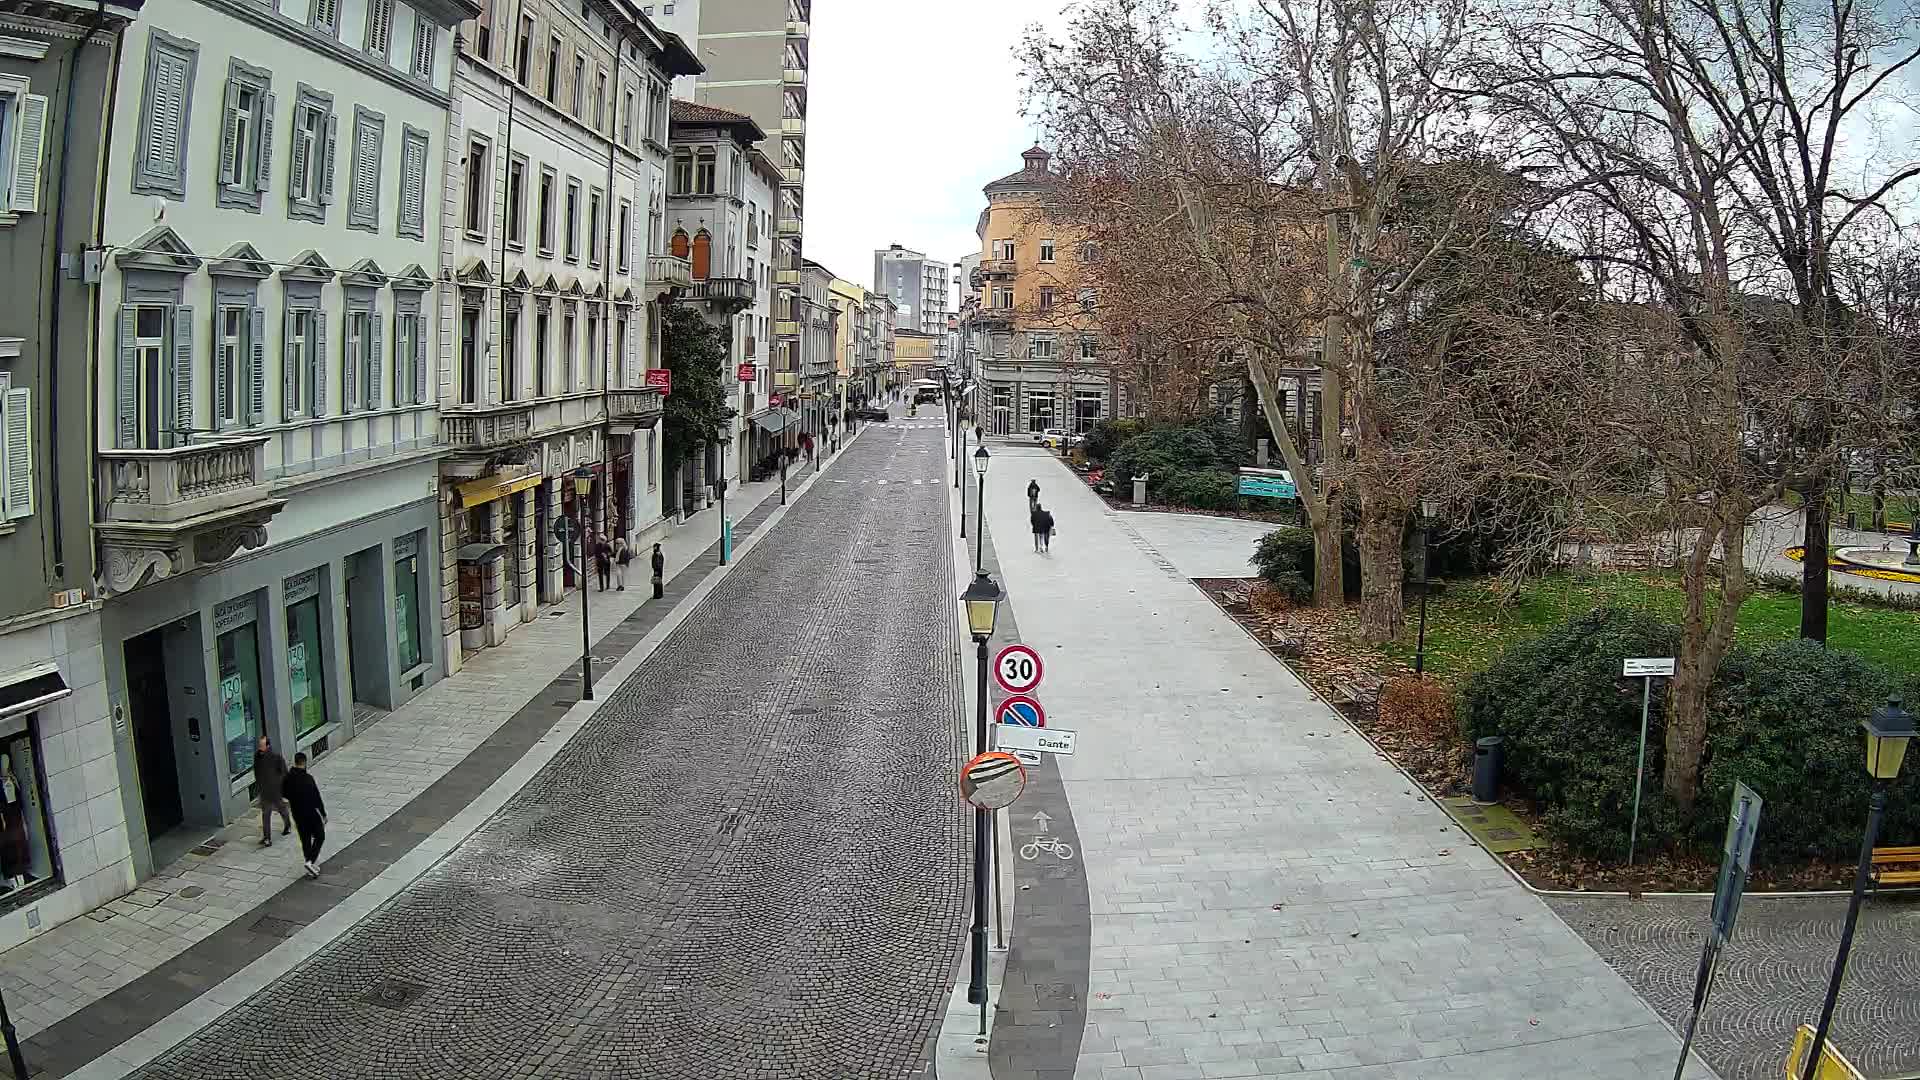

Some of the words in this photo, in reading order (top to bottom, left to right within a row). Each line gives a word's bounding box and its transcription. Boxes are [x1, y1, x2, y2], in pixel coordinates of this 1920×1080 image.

[1005, 658, 1033, 680] 30
[222, 677, 241, 700] 130
[1038, 738, 1070, 749] Dante
